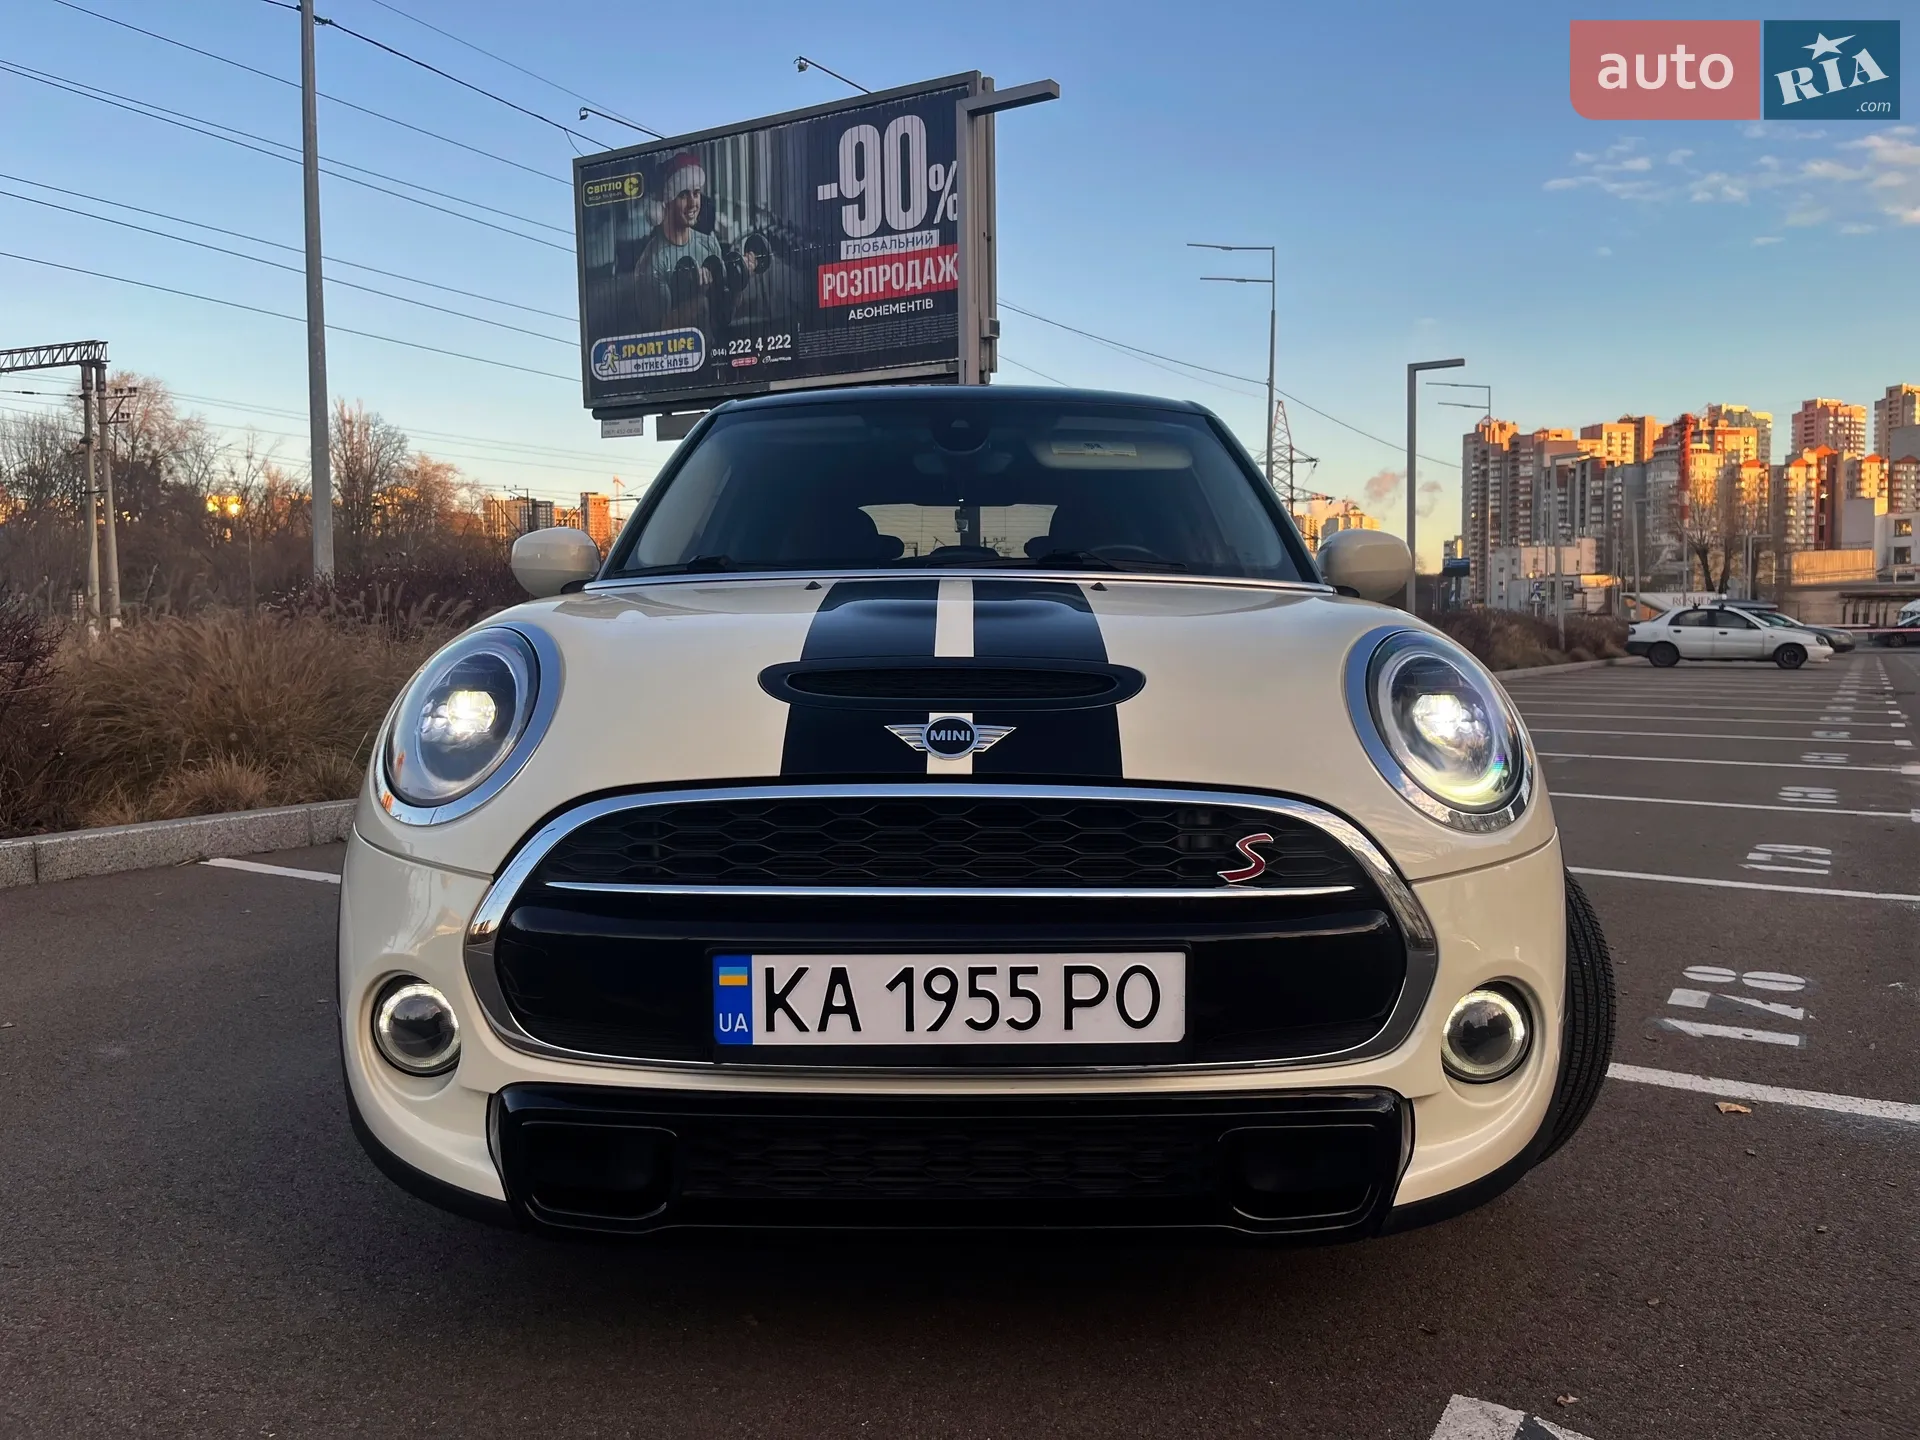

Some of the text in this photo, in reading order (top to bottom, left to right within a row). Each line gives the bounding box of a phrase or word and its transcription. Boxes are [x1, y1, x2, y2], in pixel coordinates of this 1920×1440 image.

[817, 115, 957, 238] -90%
[586, 181, 622, 195] СВІТЛО
[845, 232, 934, 255] ГЛОБАЛЬНИЙ
[822, 252, 959, 301] РОЗПРОДАЖ
[848, 298, 934, 321] АБОНЕМЕНТІВ
[622, 337, 695, 359] SPORT LIFE
[728, 338, 752, 355] 222
[755, 337, 764, 352] 4
[767, 333, 792, 351] 222
[633, 357, 690, 371] ФІТНЕС КЛУБ
[930, 730, 971, 741] MINI
[1217, 833, 1274, 883] S
[765, 964, 1161, 1032] KA 1955 PO
[719, 1012, 748, 1033] UA
